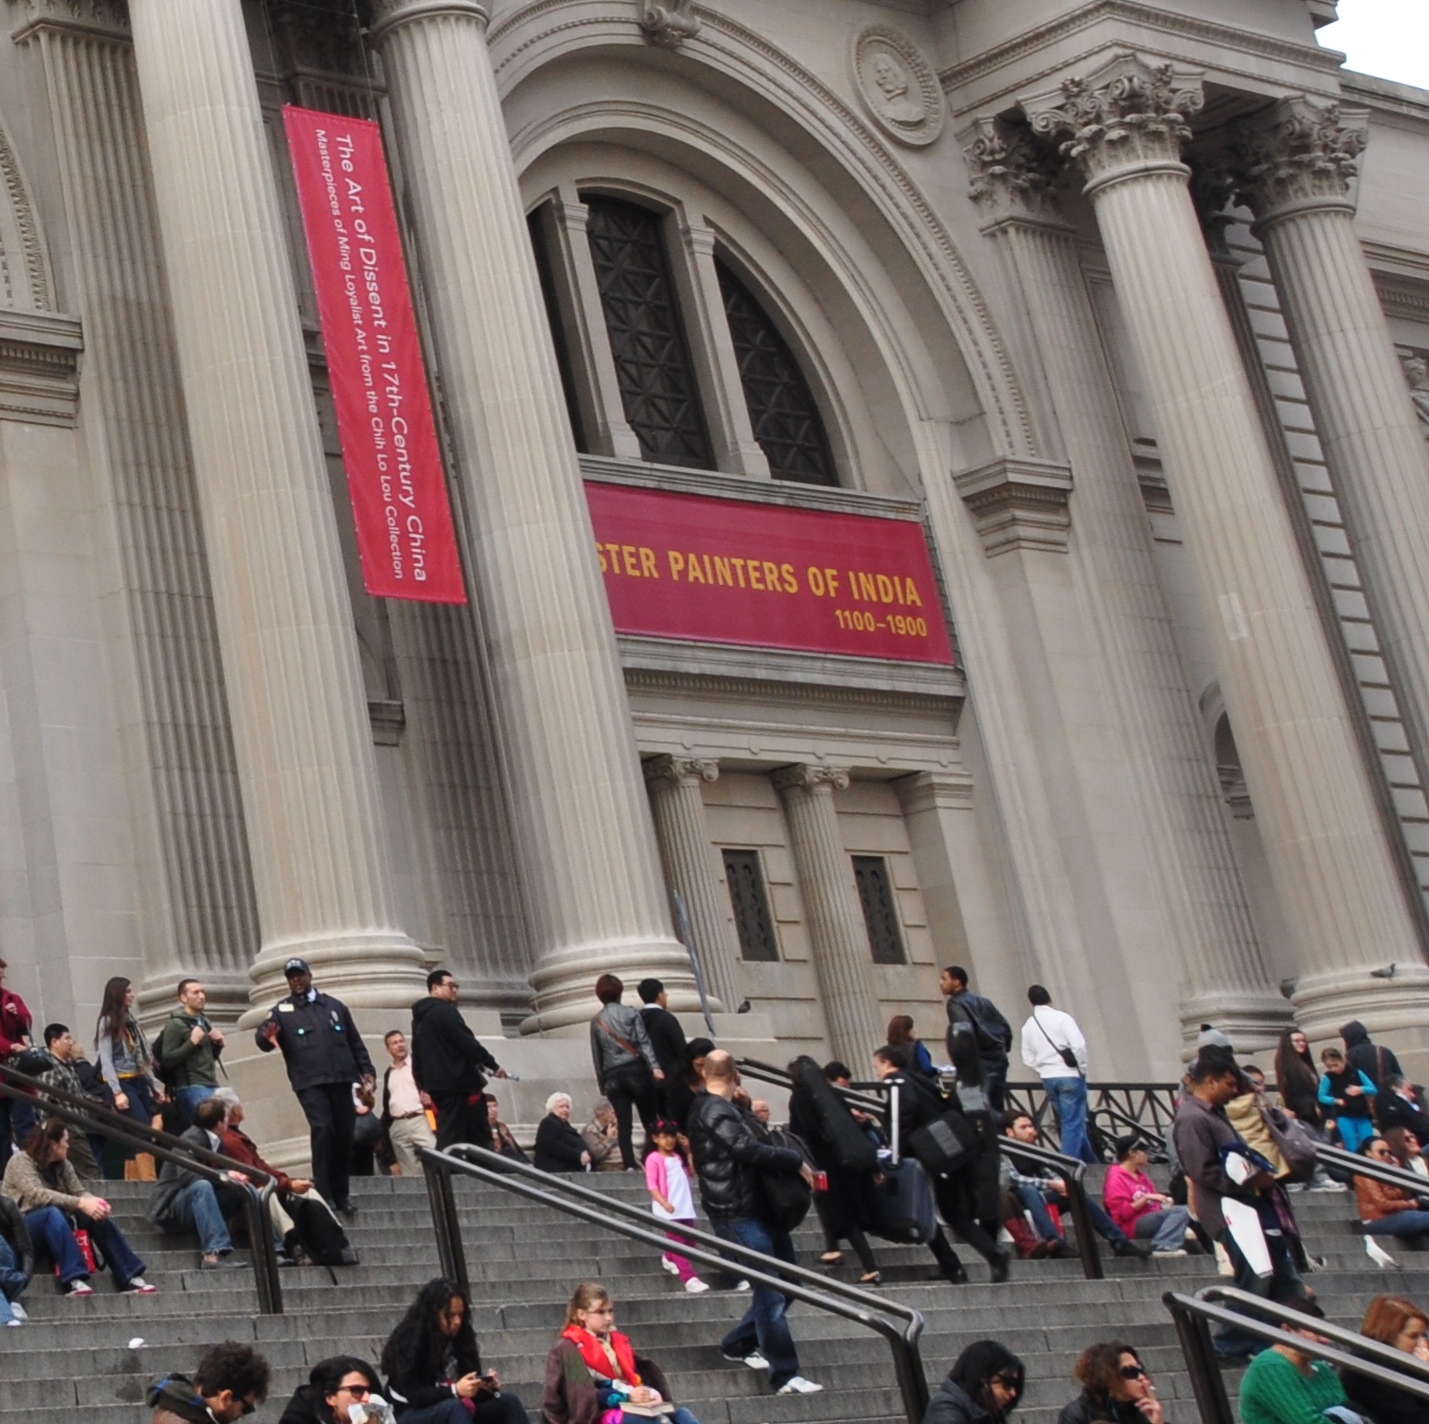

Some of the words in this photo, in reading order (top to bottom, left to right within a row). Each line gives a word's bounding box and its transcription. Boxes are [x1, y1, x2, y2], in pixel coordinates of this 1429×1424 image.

[335, 133, 355, 174] The
[315, 128, 340, 216] Masterpieces
[344, 176, 364, 212] Art
[334, 218, 349, 234] of
[354, 219, 375, 243] of
[337, 235, 352, 271] Ming
[345, 274, 363, 325] Loyalist
[359, 247, 388, 328] Dissent
[354, 328, 368, 351] Art
[376, 335, 392, 354] in
[359, 354, 373, 387] from
[366, 390, 378, 414] the
[371, 416, 387, 450] Chih
[381, 360, 416, 509] 17th-Century
[376, 453, 388, 472] Lo
[385, 505, 404, 579] Collection
[406, 514, 427, 582] China
[667, 549, 798, 594] PAINTERS
[807, 566, 840, 597] OF
[848, 571, 922, 607] INDIA
